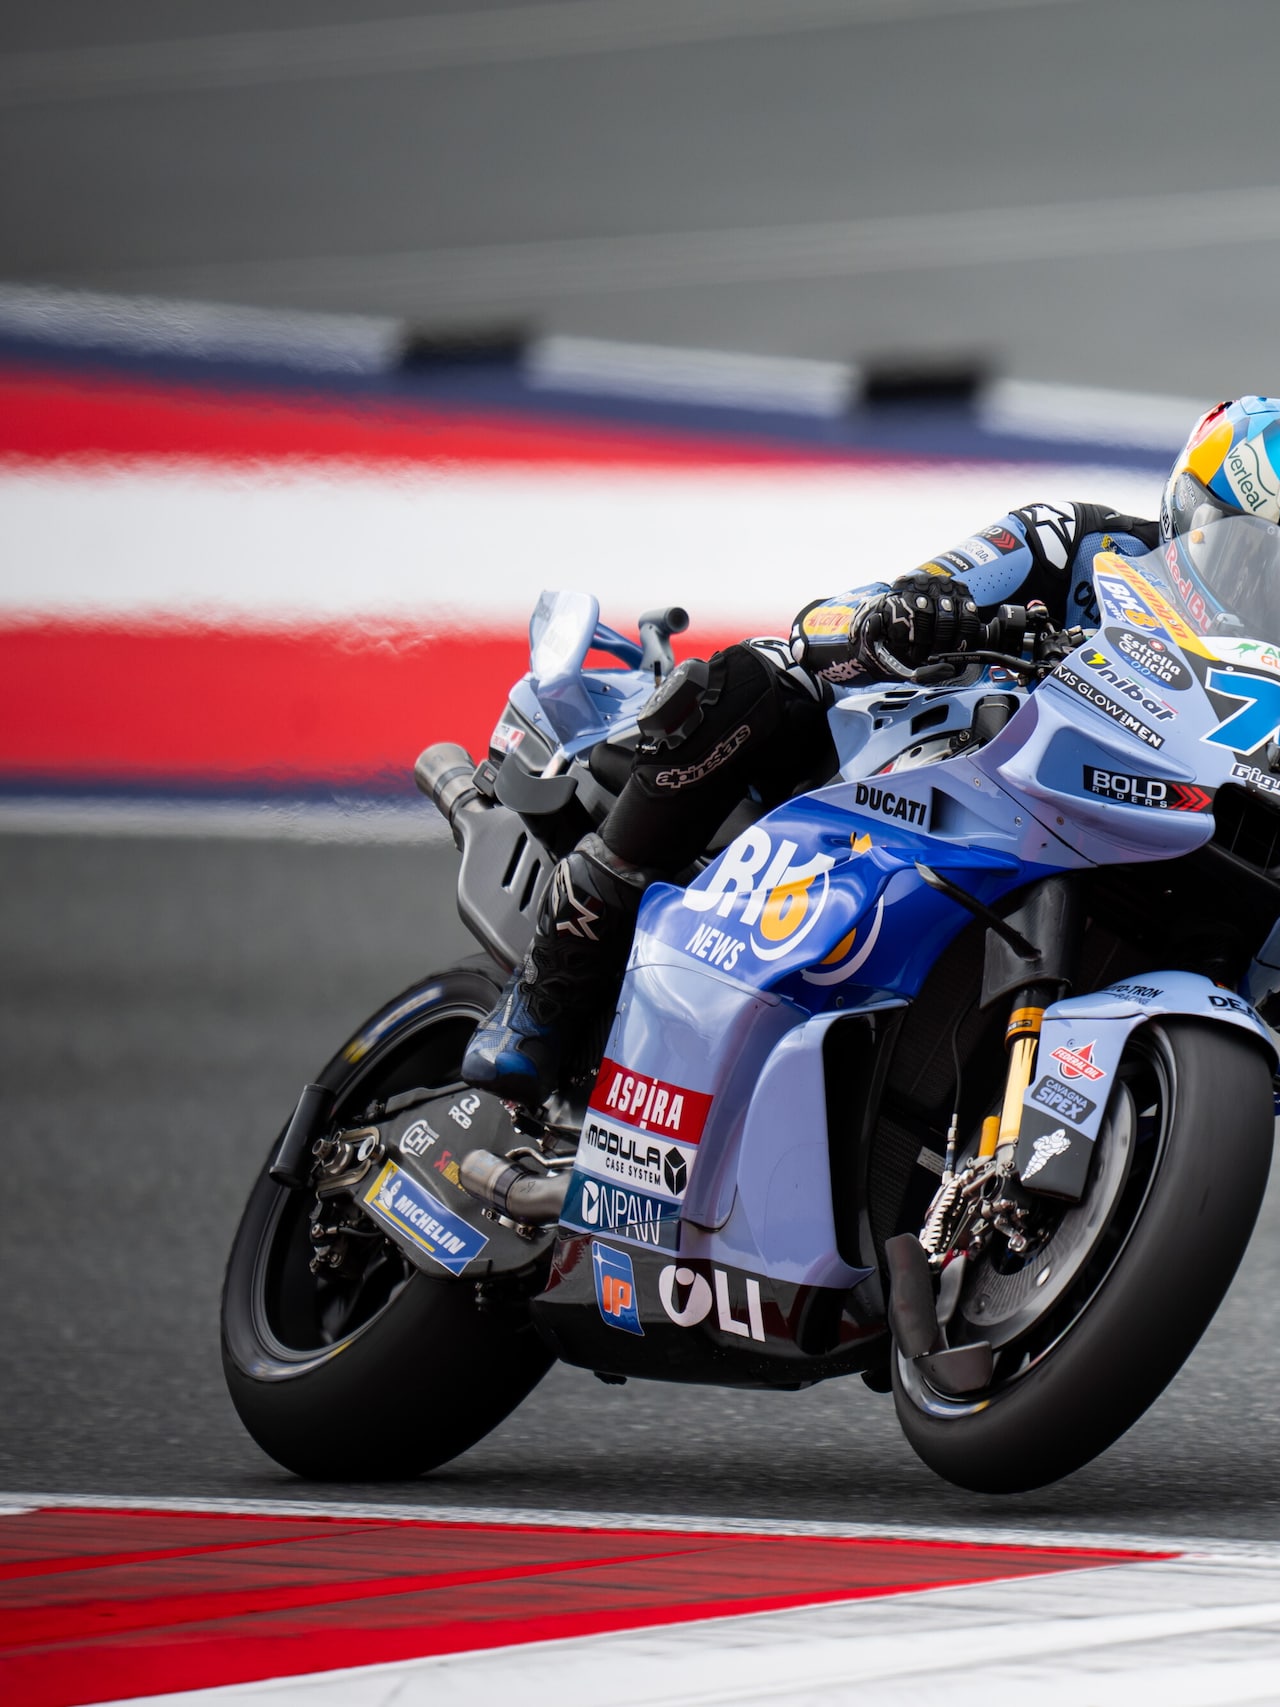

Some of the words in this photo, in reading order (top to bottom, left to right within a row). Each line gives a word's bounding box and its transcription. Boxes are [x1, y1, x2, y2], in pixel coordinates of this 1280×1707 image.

[1165, 541, 1193, 603] Red
[1187, 590, 1213, 634] Bu
[1119, 641, 1172, 682] Galicia
[1120, 633, 1181, 675] Estrella
[1054, 664, 1079, 686] MS
[1077, 682, 1123, 716] GLOW
[1080, 647, 1177, 721] Unibat
[856, 783, 927, 825] DUCATI
[1092, 770, 1168, 800] BOLD
[1092, 785, 1168, 809] RIDERS
[685, 923, 746, 970] NEWS
[1055, 1049, 1085, 1071] FEDERAL
[1083, 1066, 1100, 1078] OIL
[1036, 1087, 1083, 1119] SIPEX
[1046, 1079, 1088, 1108] CAVAGNA
[448, 1105, 472, 1129] RCB
[587, 1123, 661, 1171] MODULA
[605, 1157, 624, 1174] CASE
[628, 1165, 661, 1186] SYSTEM
[394, 1195, 466, 1255] MICHELIN
[602, 1275, 632, 1317] IP
[659, 1265, 766, 1342] OLI
